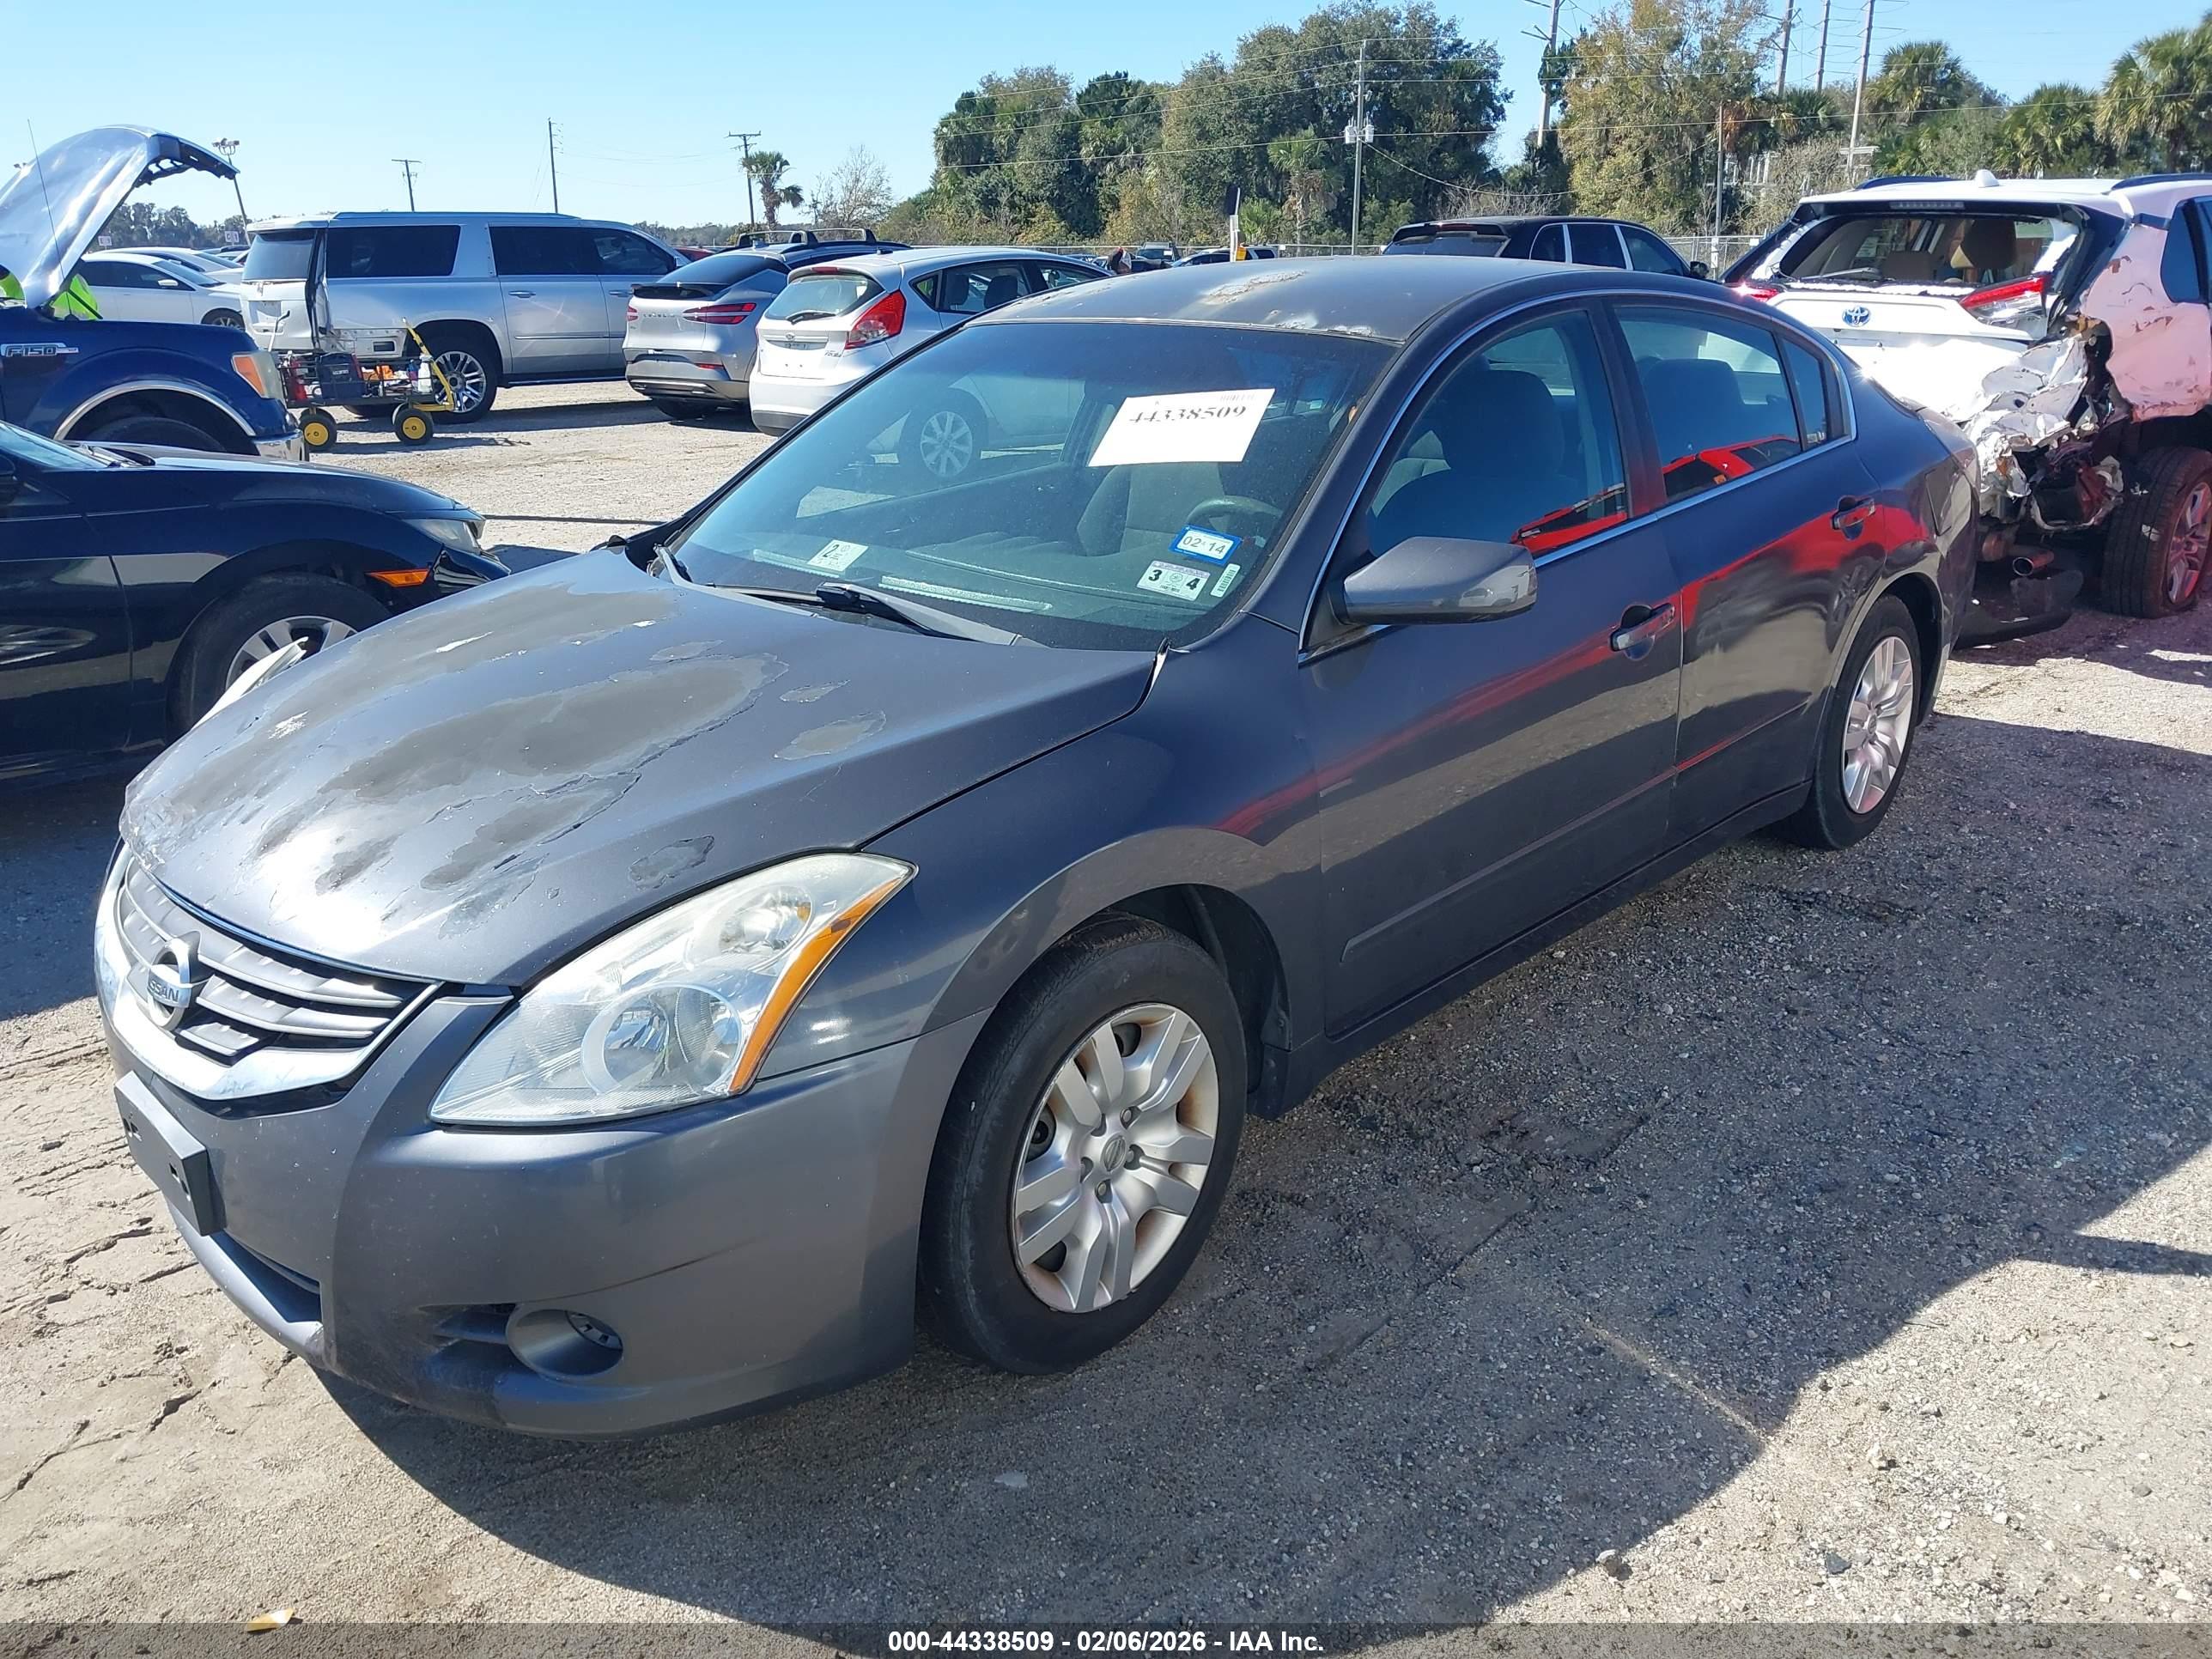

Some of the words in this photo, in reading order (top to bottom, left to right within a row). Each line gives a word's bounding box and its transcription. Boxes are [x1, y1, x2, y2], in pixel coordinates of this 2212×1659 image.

[1129, 405, 1247, 423] 44338509
[822, 544, 840, 558] 2
[1148, 569, 1163, 582] 3
[1186, 577, 1201, 590] 4
